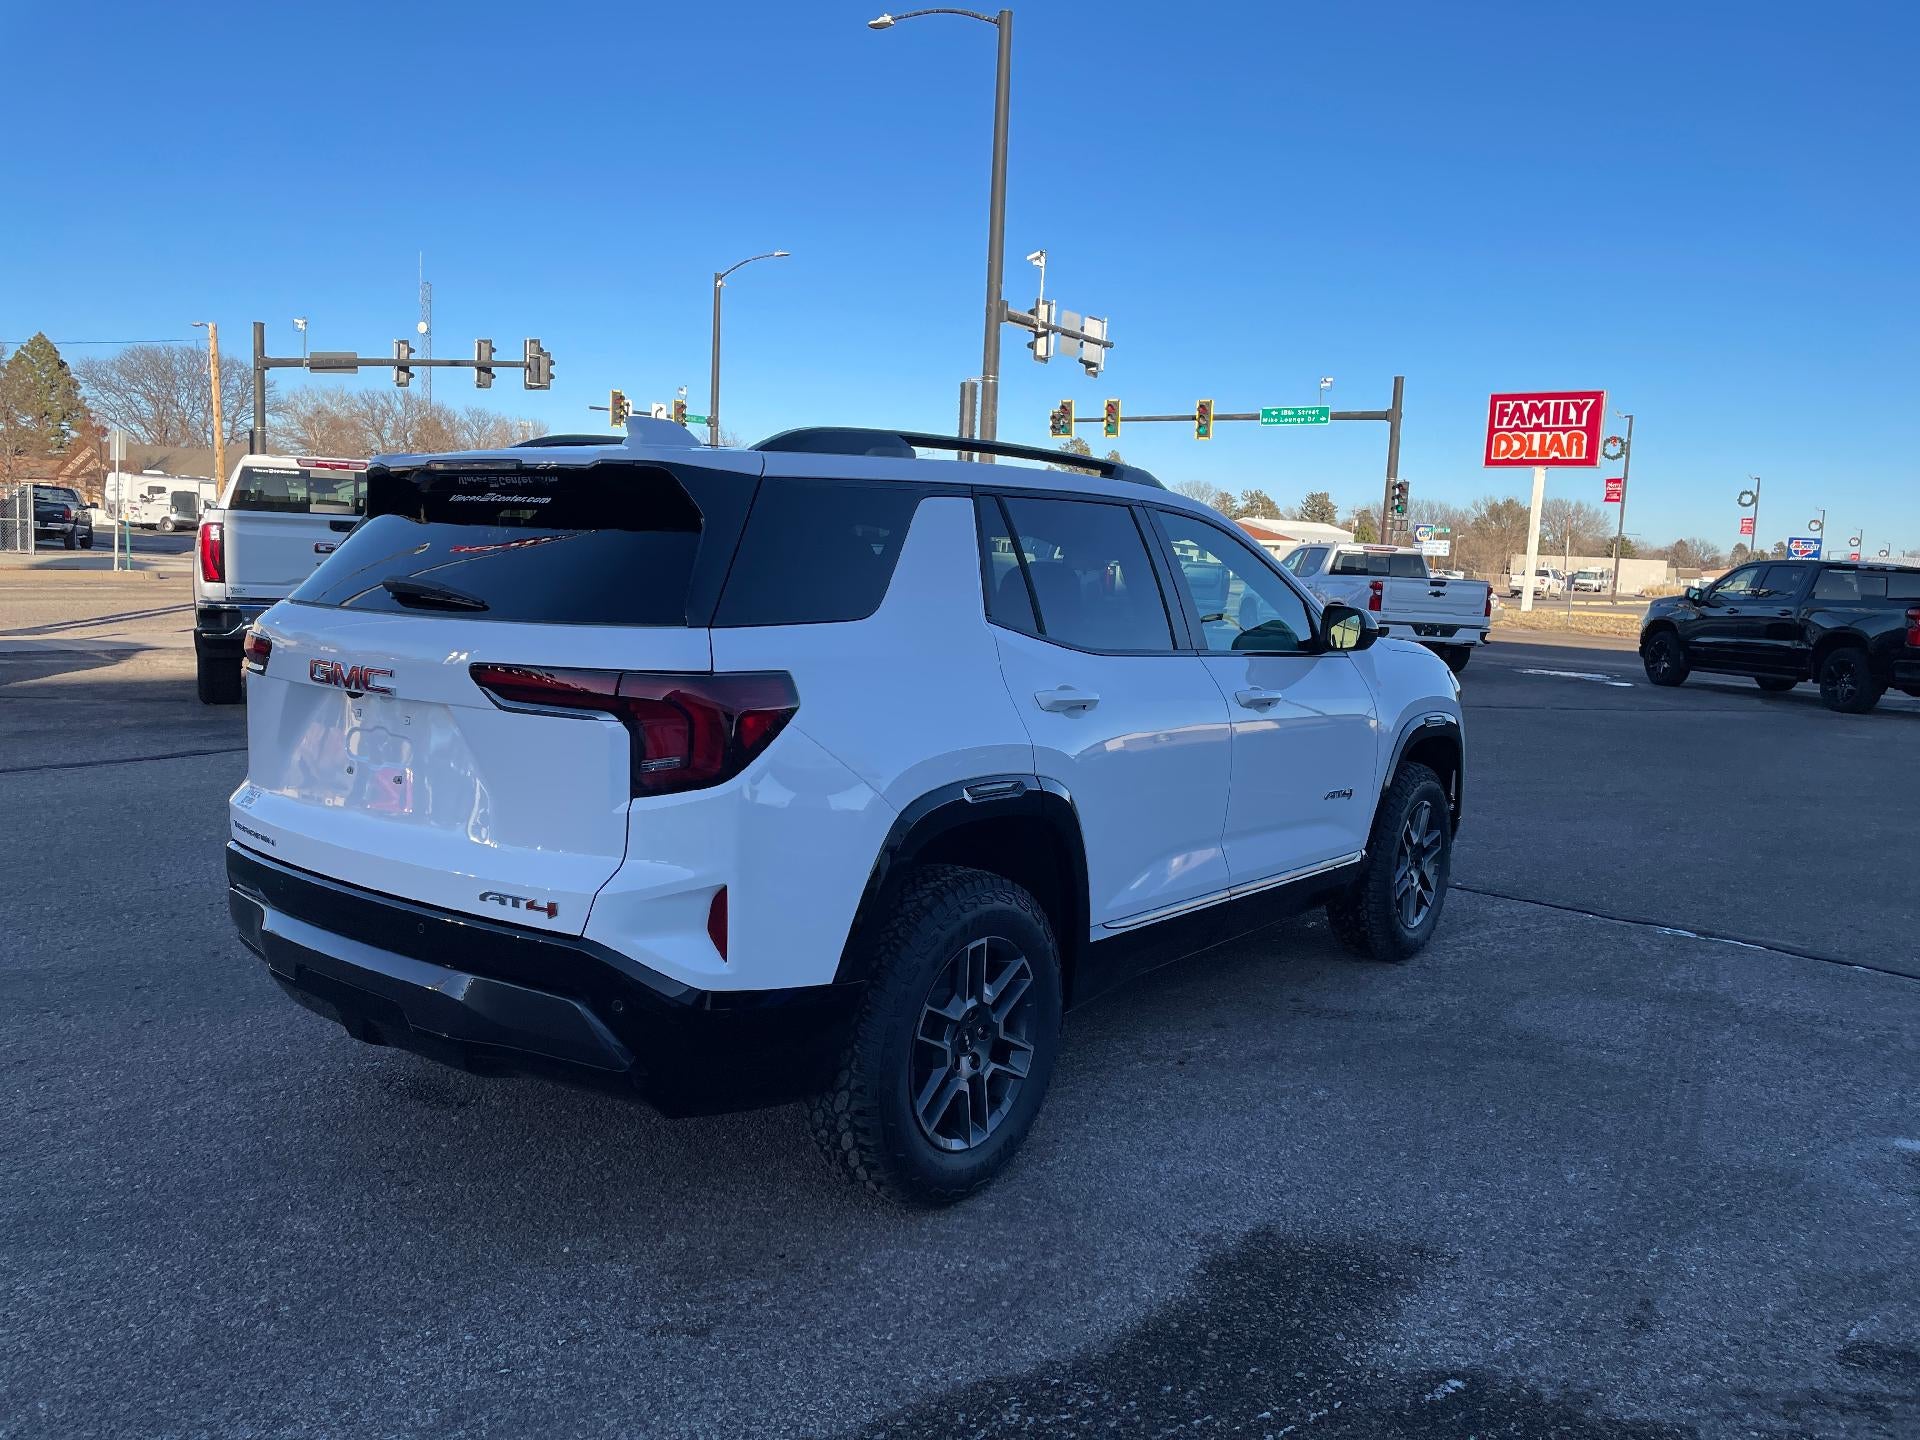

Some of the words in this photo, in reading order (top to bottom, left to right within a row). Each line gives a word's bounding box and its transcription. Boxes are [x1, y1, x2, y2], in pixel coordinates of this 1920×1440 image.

[1494, 399, 1596, 428] FAMILY
[1491, 430, 1587, 459] DOLLAR
[309, 659, 396, 697] GMC
[1323, 788, 1353, 801] AT4
[478, 891, 559, 920] AT4
